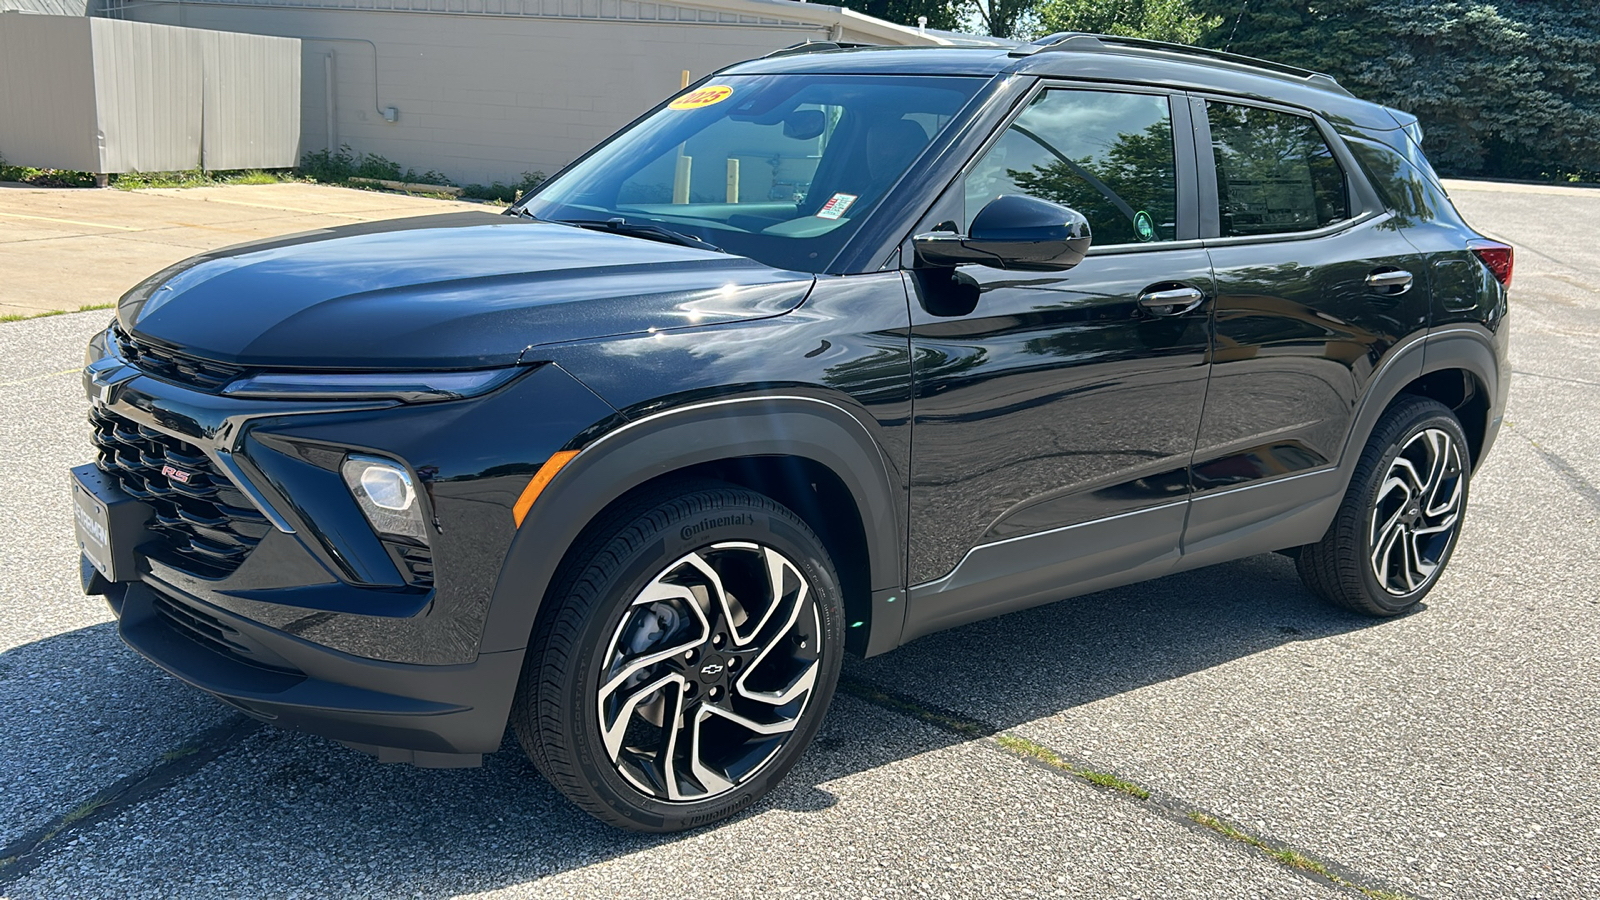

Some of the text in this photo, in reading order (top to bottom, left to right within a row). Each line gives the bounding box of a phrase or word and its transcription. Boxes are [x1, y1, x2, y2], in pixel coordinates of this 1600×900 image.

[673, 91, 729, 105] 2025
[162, 465, 190, 482] RS
[681, 513, 745, 540] Continental
